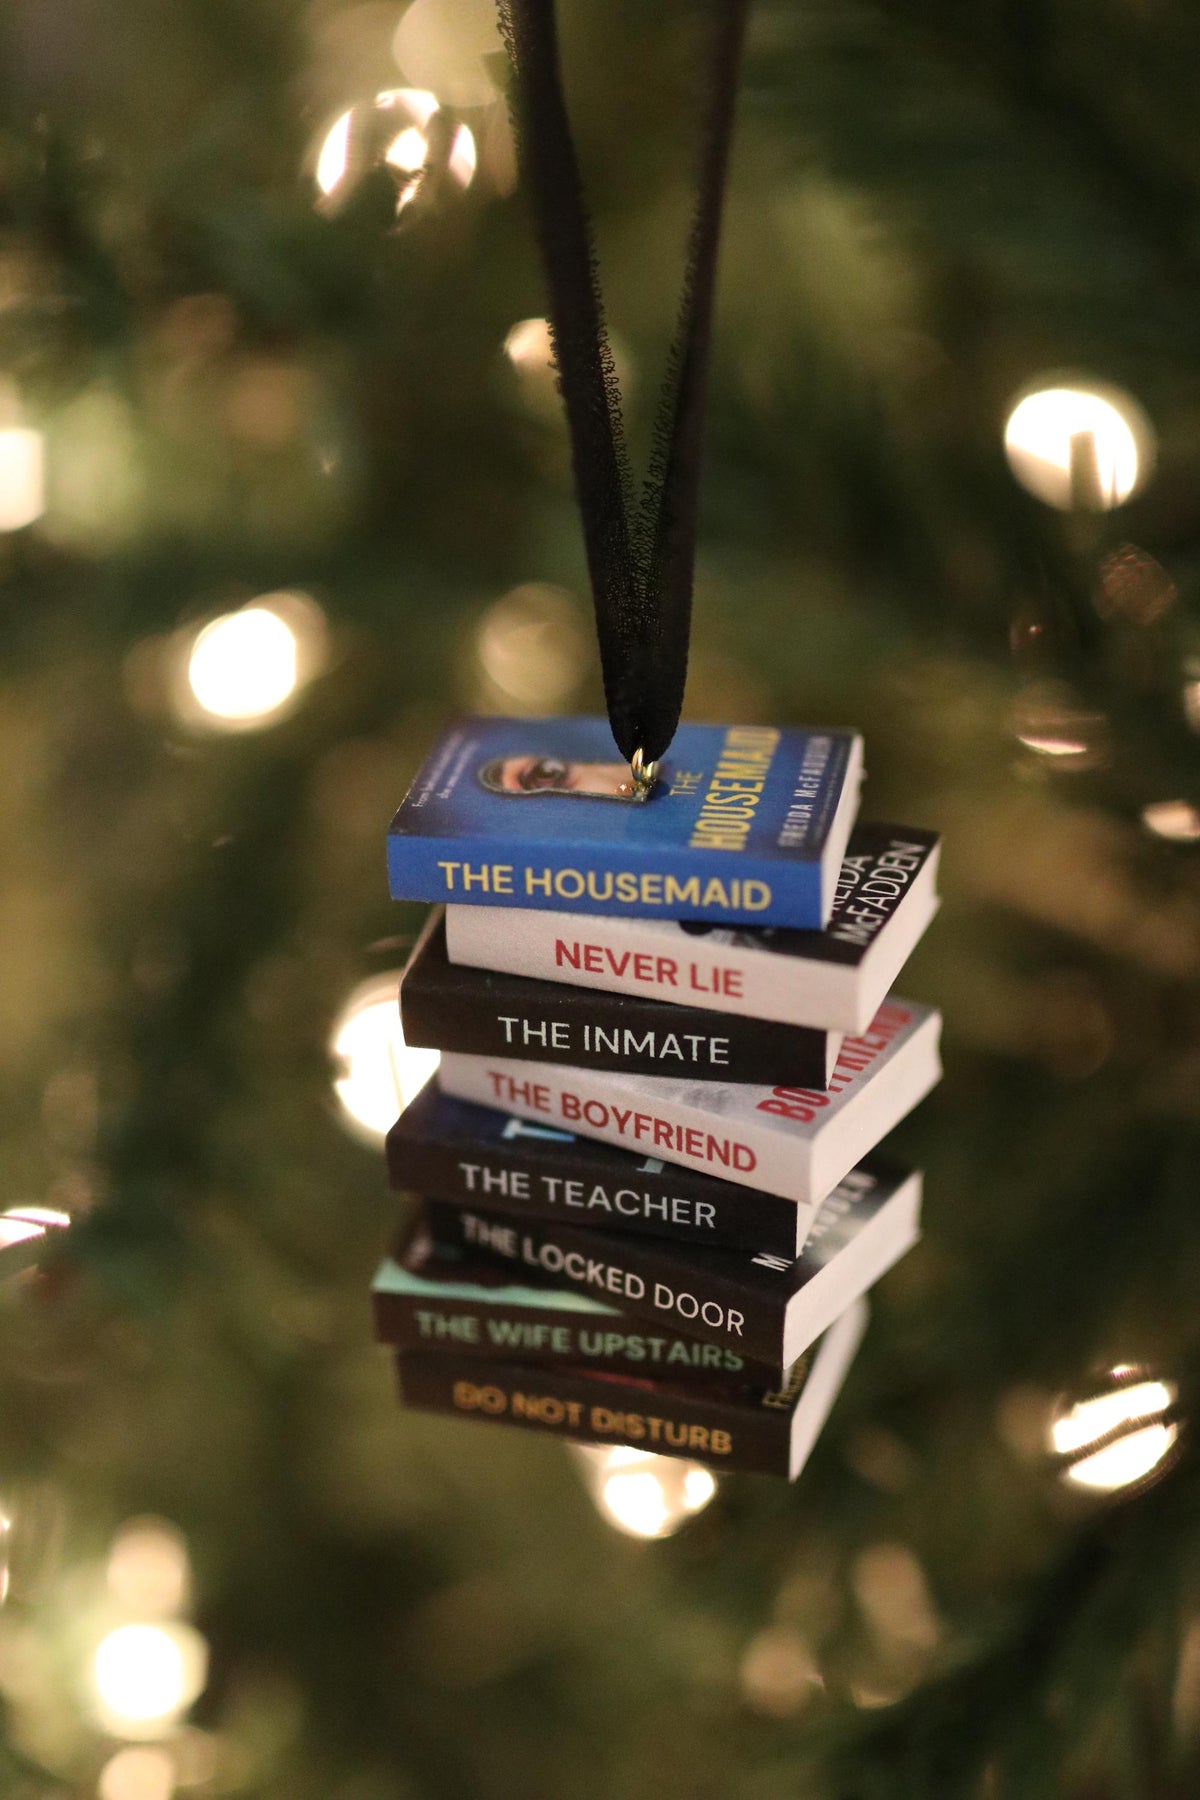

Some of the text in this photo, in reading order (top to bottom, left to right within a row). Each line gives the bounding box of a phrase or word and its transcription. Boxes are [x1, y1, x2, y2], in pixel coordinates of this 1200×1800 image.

[671, 770, 703, 797] THE
[437, 861, 773, 911] THE HOUSEMAID
[555, 939, 743, 998] NEVER LIE
[498, 1016, 730, 1065] THE INMATE
[489, 1070, 551, 1113] THE
[560, 1092, 757, 1172] BOYFRIEND
[459, 1163, 530, 1199] THE
[541, 1176, 716, 1228] TEACHER
[461, 1212, 745, 1337] THE LOCKED DOOR
[416, 1310, 745, 1372] THE WIFE UPSTAIRS
[453, 1381, 733, 1455] DO NOT DISTURB
